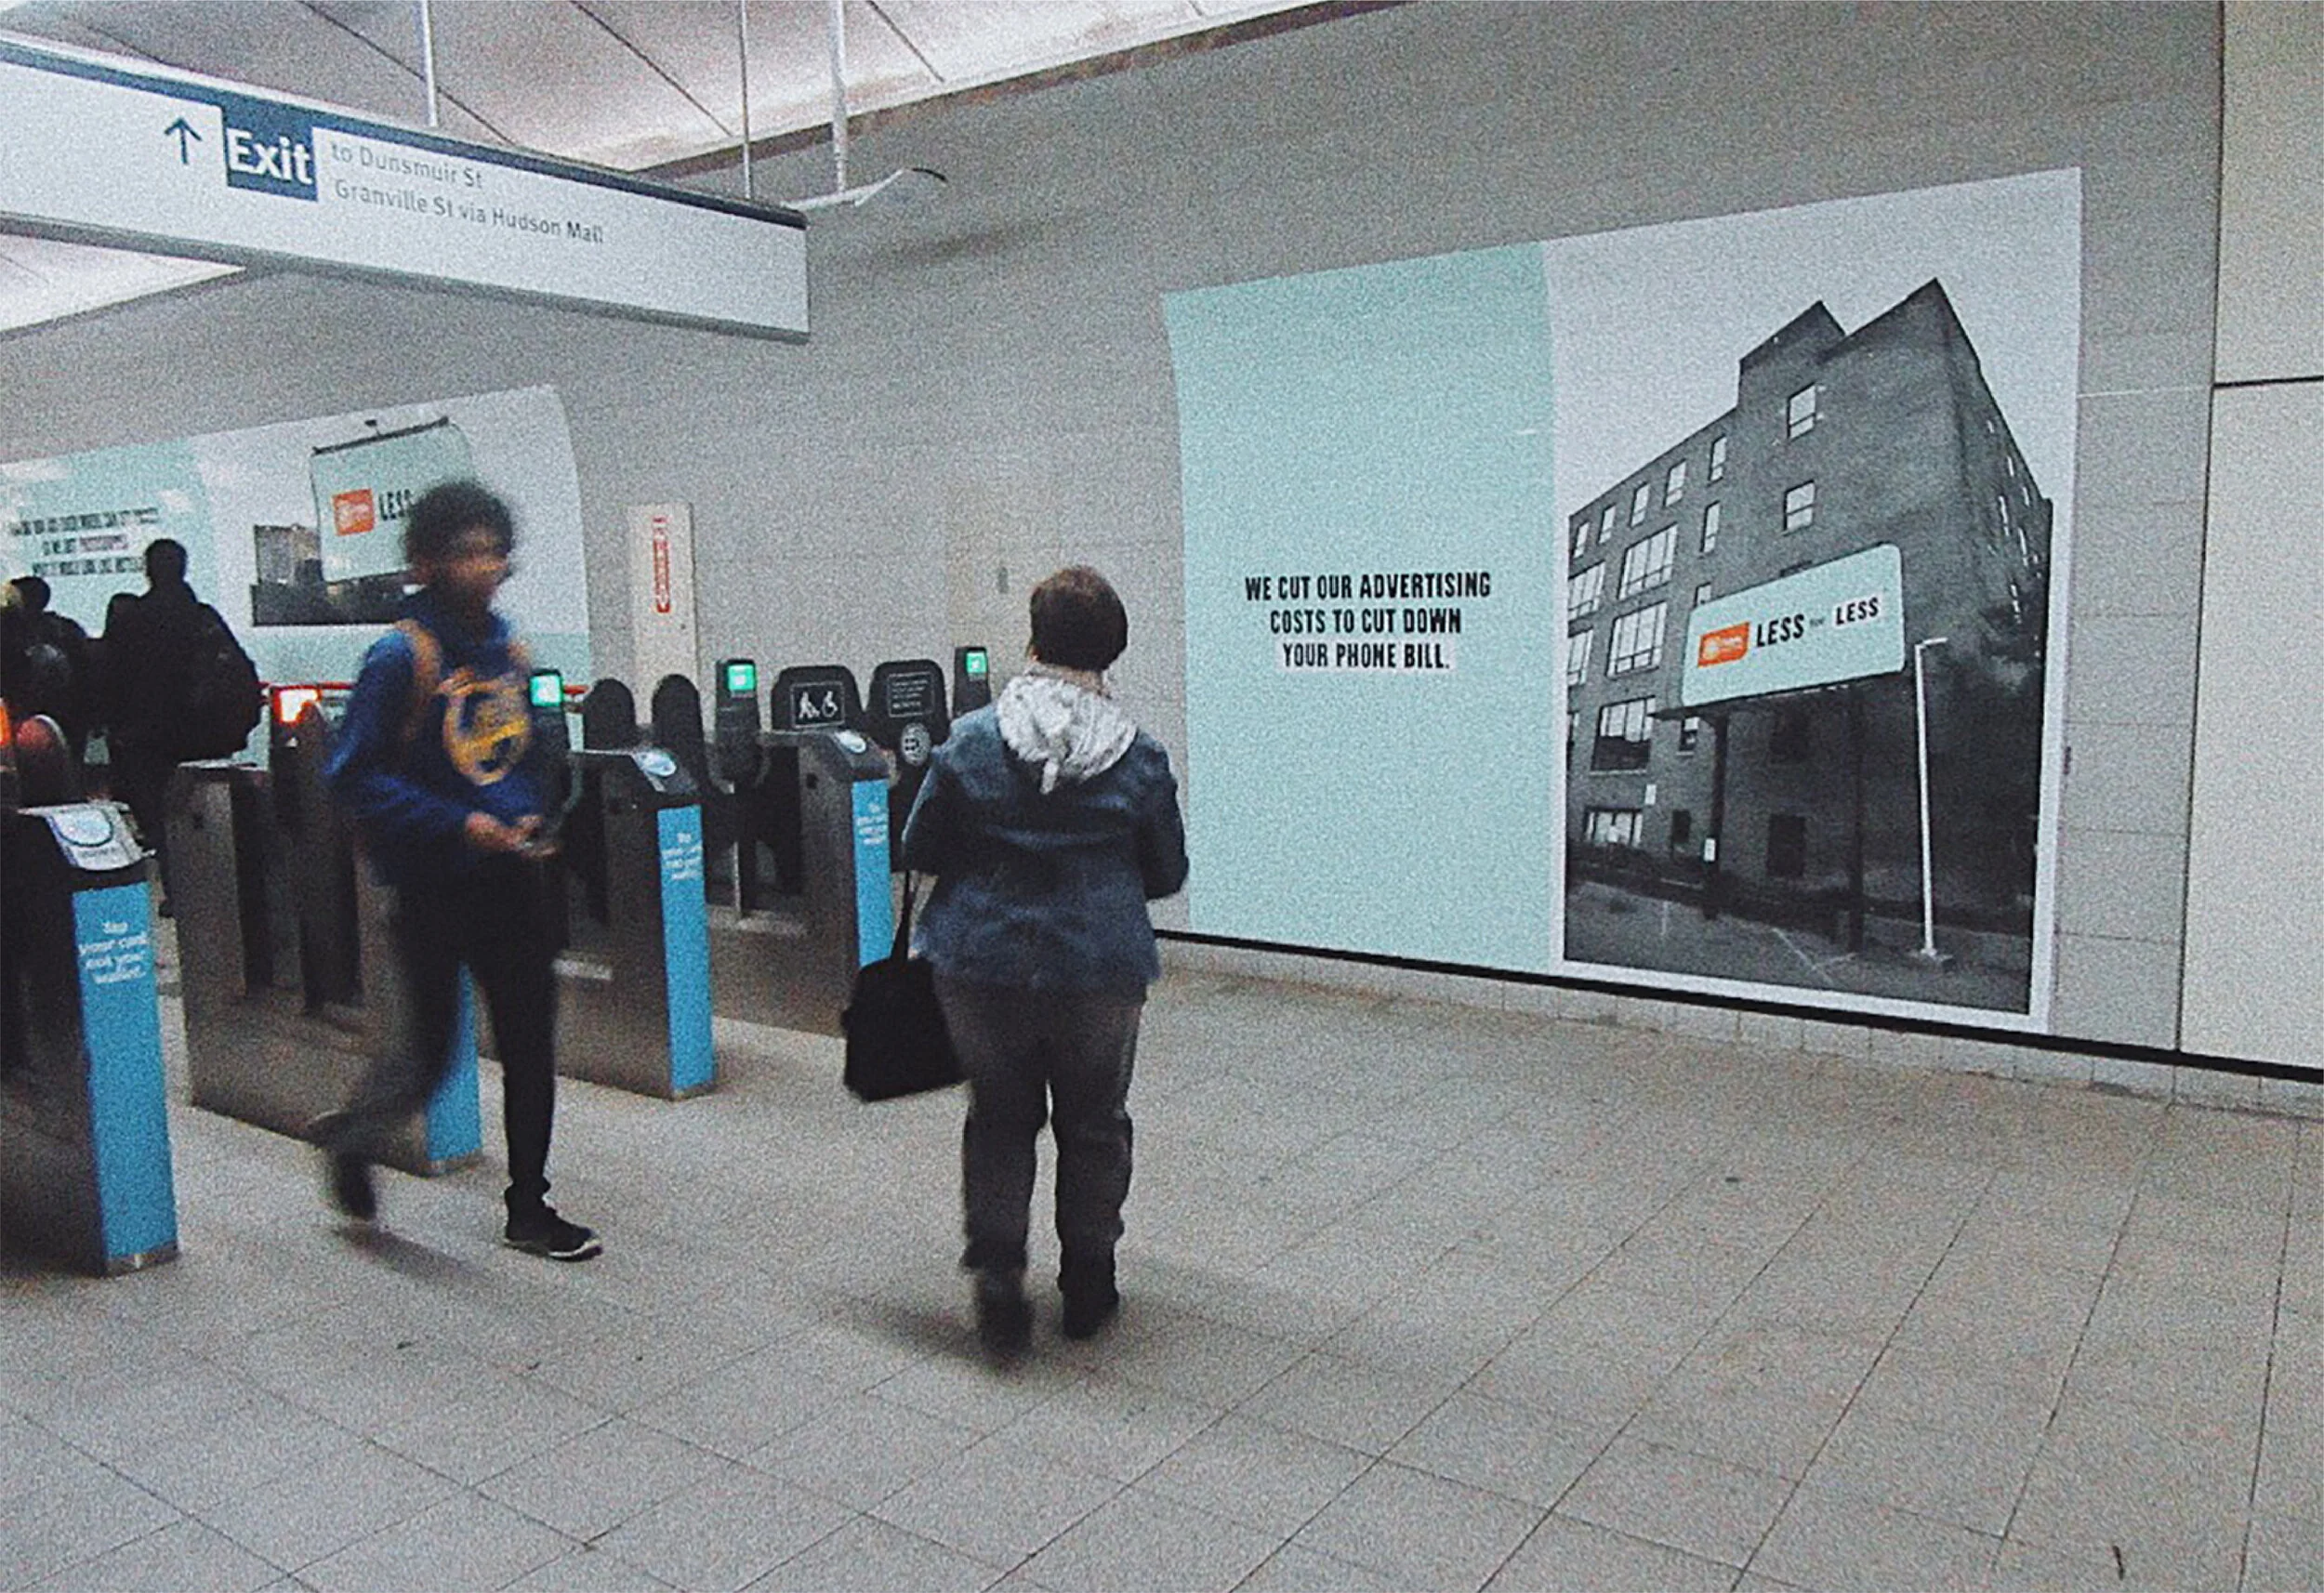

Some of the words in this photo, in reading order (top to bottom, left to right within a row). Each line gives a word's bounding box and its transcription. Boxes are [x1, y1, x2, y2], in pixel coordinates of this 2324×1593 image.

[226, 127, 313, 185] Exit
[332, 141, 353, 163] to
[360, 145, 457, 184] Dunsmuir
[464, 167, 482, 188] St
[335, 178, 428, 214] Granville
[433, 195, 453, 217] St
[458, 202, 486, 223] via
[493, 207, 561, 234] Hudson
[1245, 576, 1272, 600] WE
[1277, 575, 1311, 600] CUT
[1316, 574, 1353, 599] OUR
[1360, 572, 1491, 599] ADVERTISING
[1270, 608, 1327, 634] COSTS
[1332, 608, 1354, 634] TO
[1362, 608, 1395, 634] CUT
[1403, 608, 1462, 634] DOWN
[1835, 597, 1879, 625] LESS
[1756, 613, 1804, 648] LESS
[1283, 643, 1328, 667] YOUR
[1336, 643, 1396, 667] PHONE
[1404, 643, 1450, 668] BILL.
